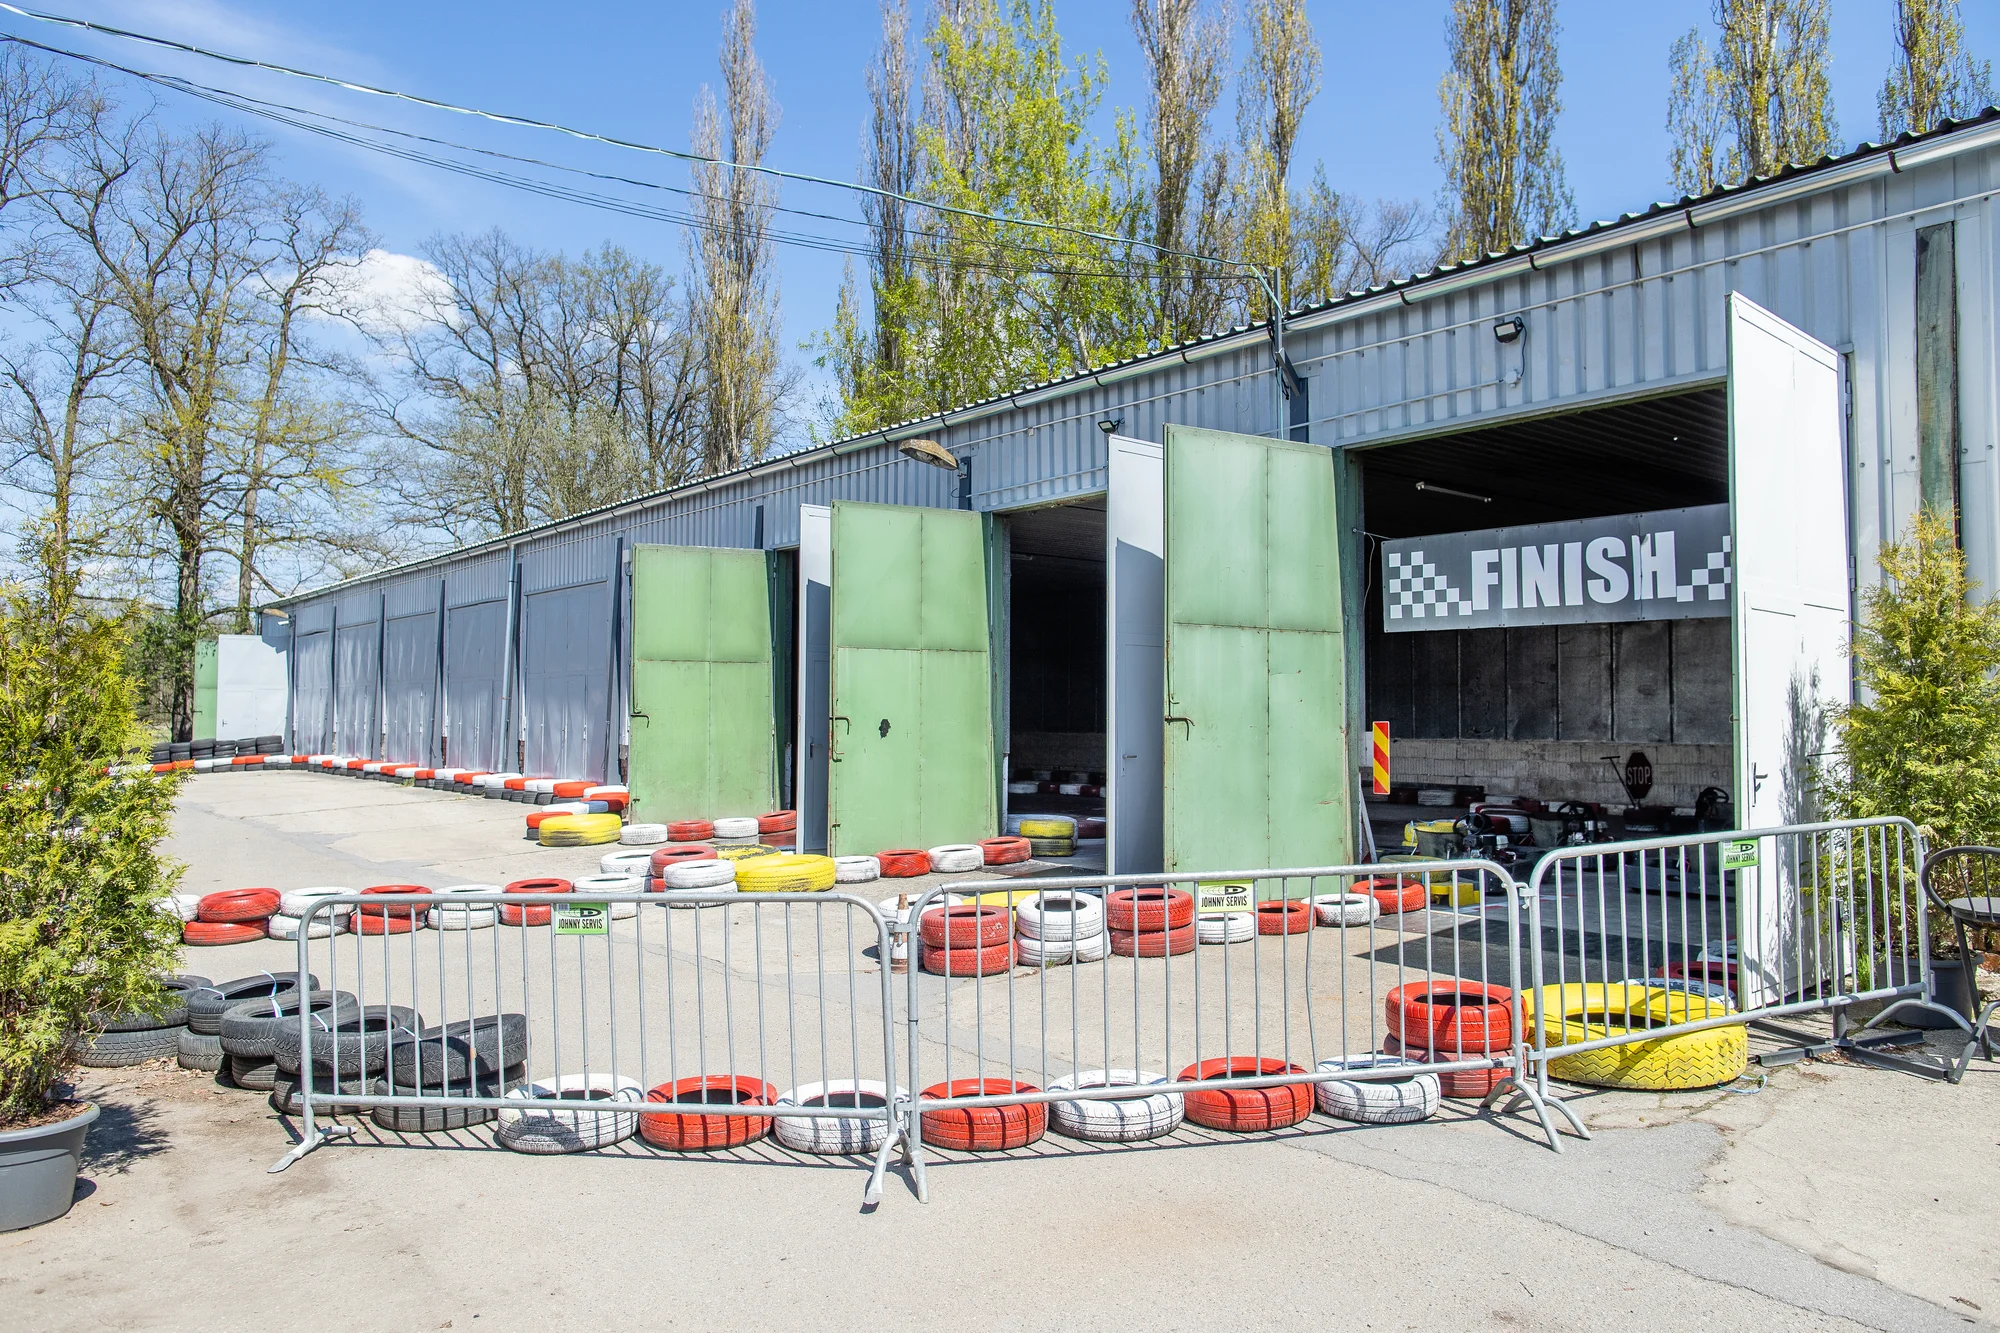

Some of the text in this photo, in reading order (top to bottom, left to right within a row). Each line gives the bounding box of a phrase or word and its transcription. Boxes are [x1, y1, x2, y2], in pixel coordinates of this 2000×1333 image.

[1471, 531, 1677, 611] FINISH
[1627, 766, 1651, 785] STOP
[1725, 852, 1755, 864] JOHNNY SERVIS
[1201, 895, 1248, 908] JOHNNY SERVIS
[558, 918, 603, 929] JOHNNY SERVIS
